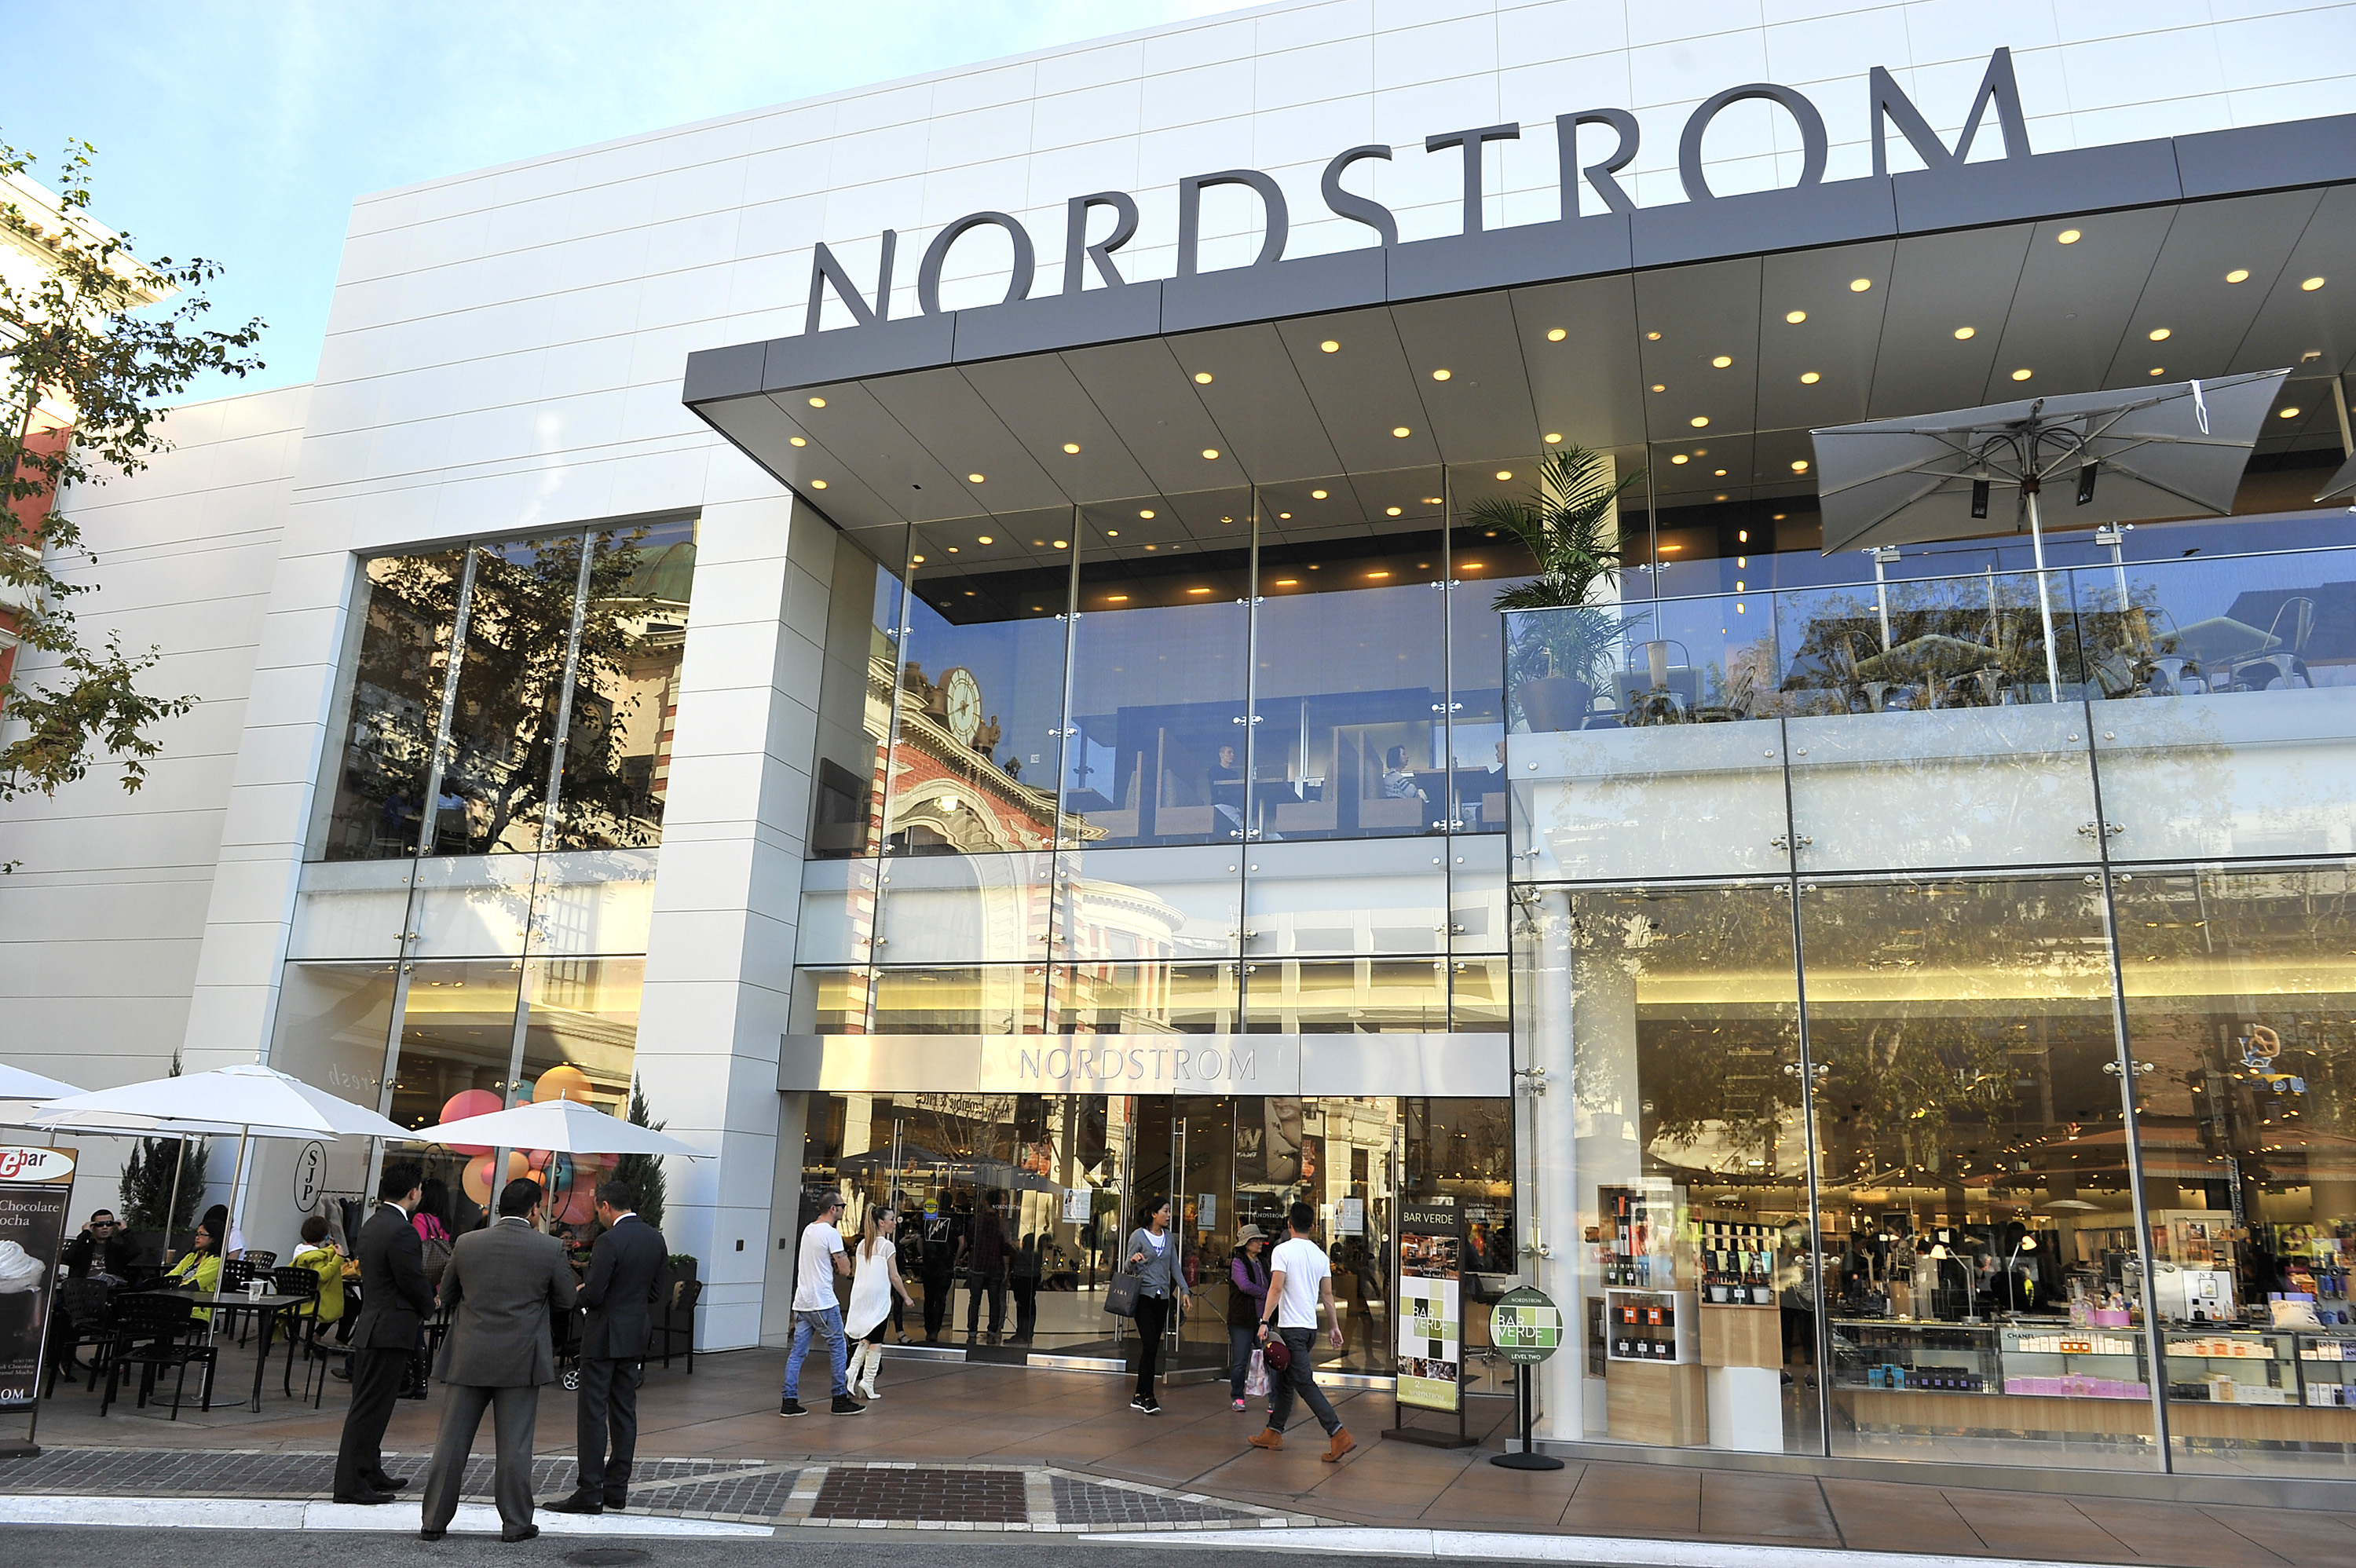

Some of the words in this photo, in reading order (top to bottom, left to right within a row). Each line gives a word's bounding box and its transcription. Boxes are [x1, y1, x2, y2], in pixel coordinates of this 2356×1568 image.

[805, 46, 2032, 335] NORDSTROM
[1020, 1048, 1256, 1080] NORDSTROM
[302, 1150, 318, 1201] SJP
[0, 1200, 60, 1212] Chocolate
[0, 1214, 30, 1226] ocha
[1403, 1212, 1421, 1223] BAR
[1423, 1213, 1454, 1225] VERDE
[1413, 1306, 1435, 1318] BAR
[1414, 1318, 1448, 1331] VERDE
[1498, 1314, 1525, 1327] BAR
[1498, 1326, 1543, 1339] VERDE
